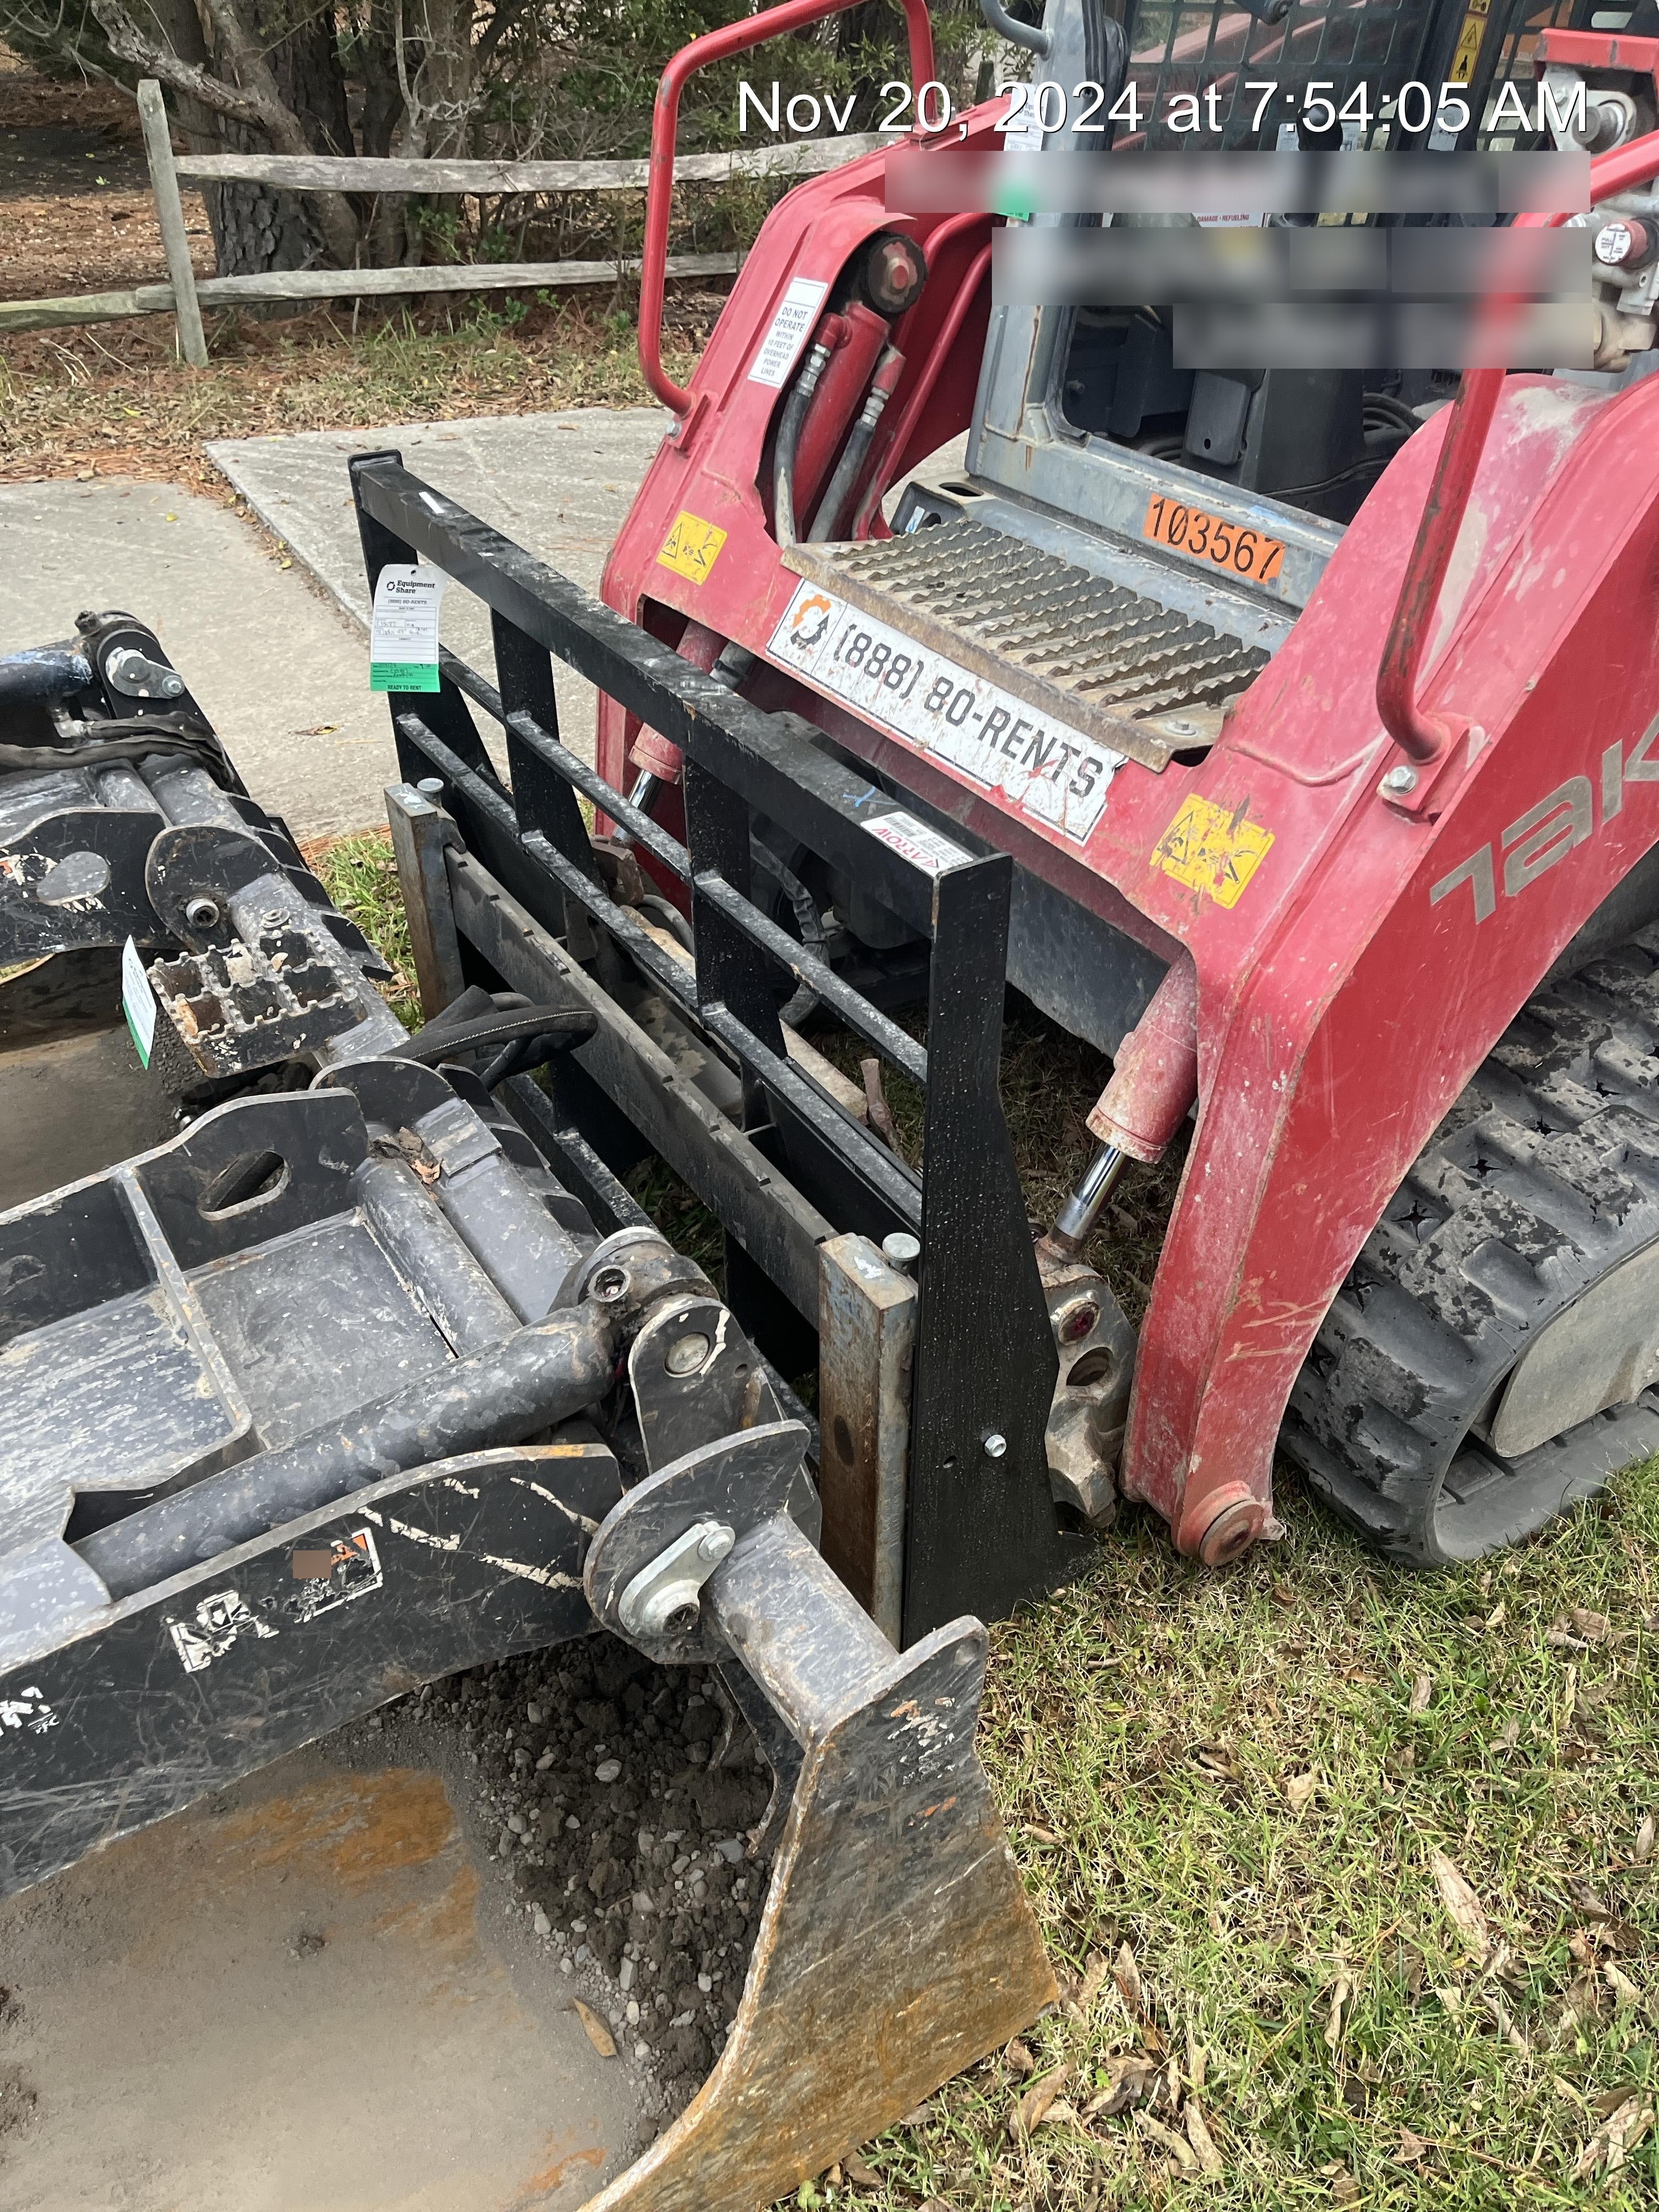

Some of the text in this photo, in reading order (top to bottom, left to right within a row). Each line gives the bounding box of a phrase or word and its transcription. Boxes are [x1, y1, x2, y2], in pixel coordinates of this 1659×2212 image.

[782, 307, 808, 320] DO NOT
[775, 318, 805, 332] OPERATE
[776, 330, 794, 341] WITHIN
[764, 348, 789, 360] OVERHEAD
[764, 358, 781, 368] POWER
[761, 368, 775, 376] LINES
[1153, 498, 1285, 579] 103567
[397, 580, 435, 589] Equipment
[833, 624, 1104, 798] (888) 80-RENTS
[871, 828, 928, 860] ARROW
